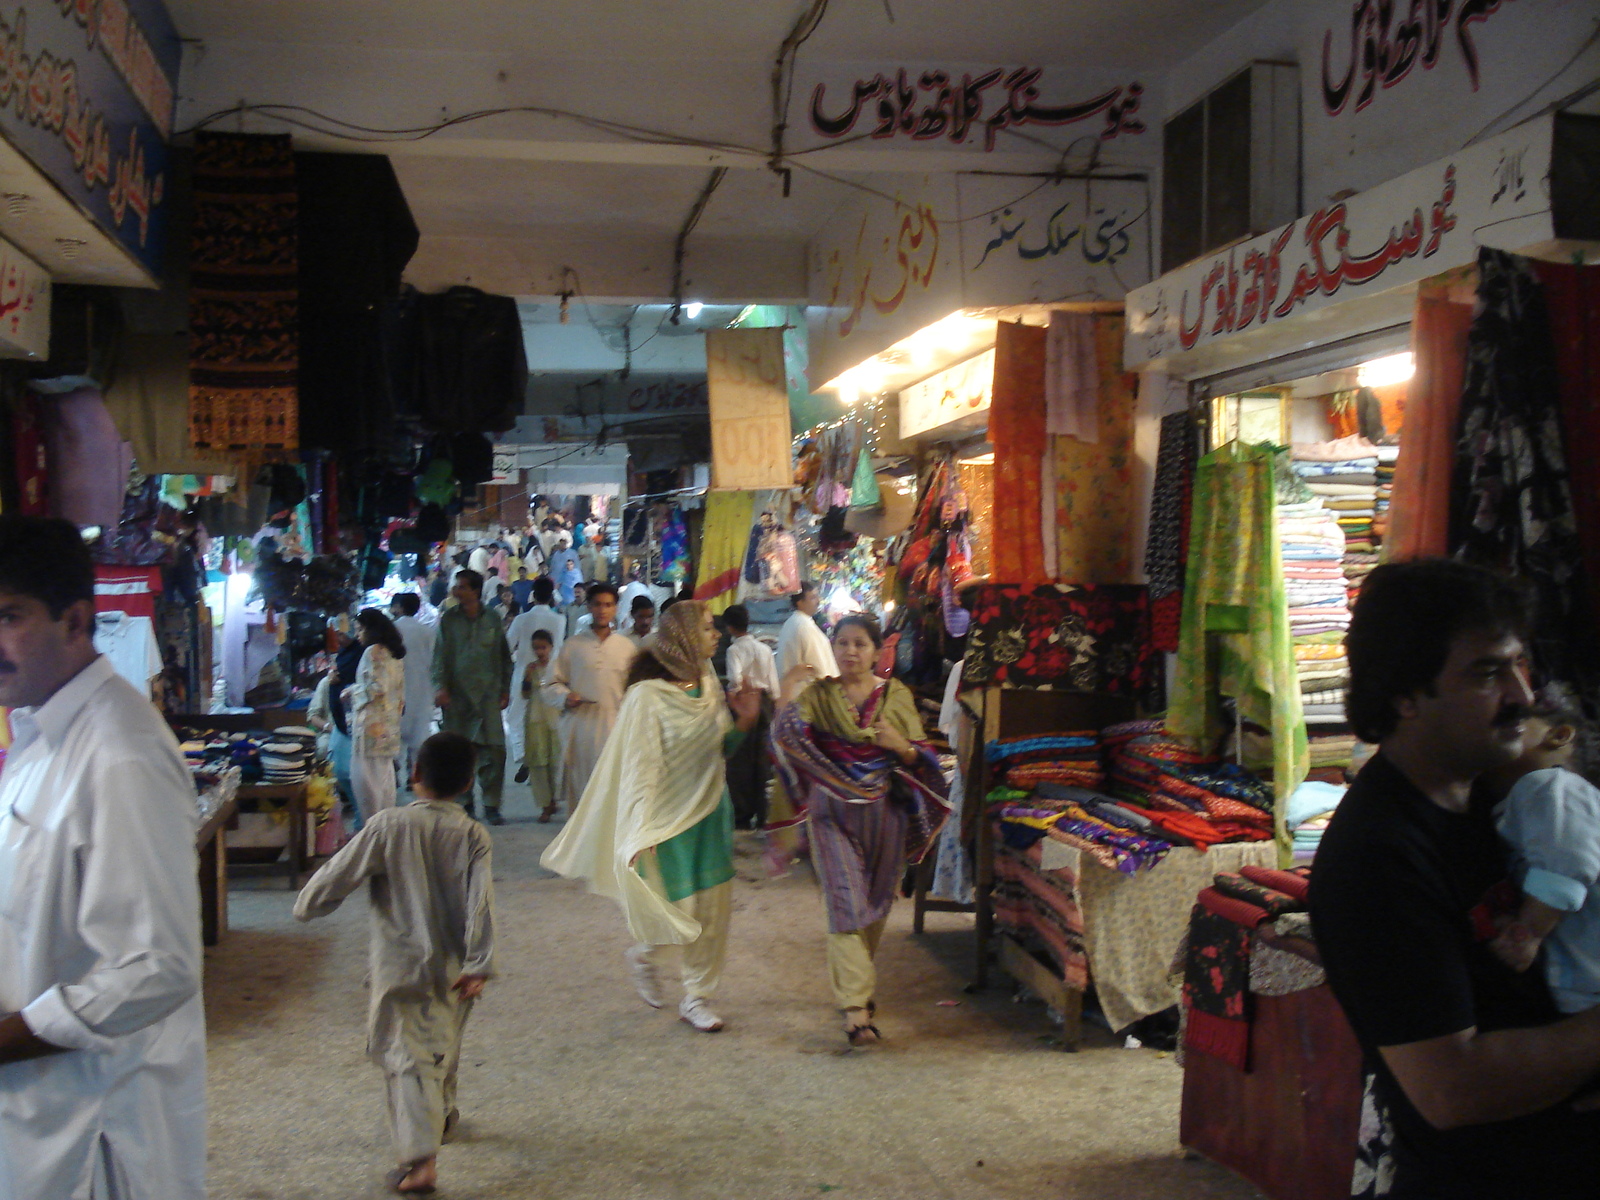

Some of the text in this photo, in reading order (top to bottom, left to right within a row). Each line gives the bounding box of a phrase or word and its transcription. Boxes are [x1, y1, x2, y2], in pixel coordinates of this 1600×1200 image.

[911, 67, 1004, 144] کلاتھ
[1100, 80, 1146, 141] نیو
[1423, 163, 1459, 259] نیو
[1236, 220, 1296, 324] کلاتھ
